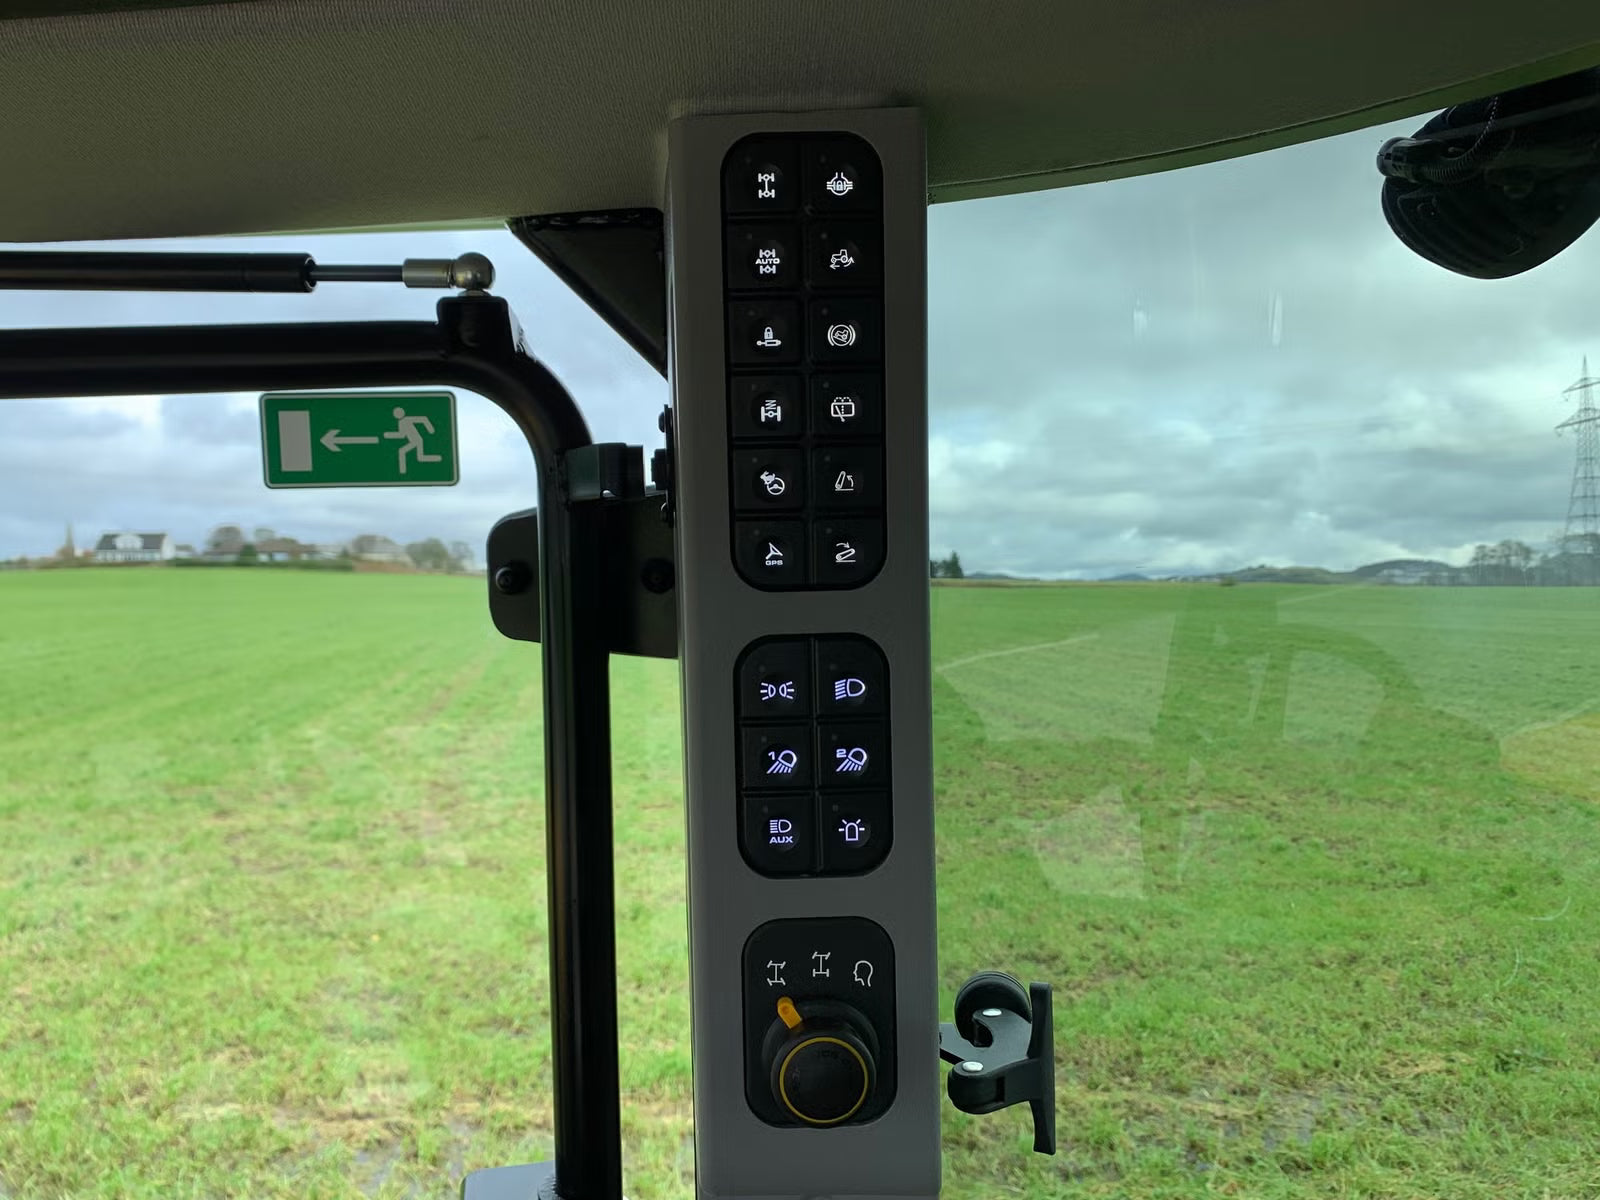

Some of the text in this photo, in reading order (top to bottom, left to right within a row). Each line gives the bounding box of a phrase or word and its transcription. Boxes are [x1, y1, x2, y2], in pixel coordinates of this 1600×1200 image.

[768, 751, 775, 760] 1
[836, 748, 847, 758] 2
[769, 836, 793, 844] AUX
